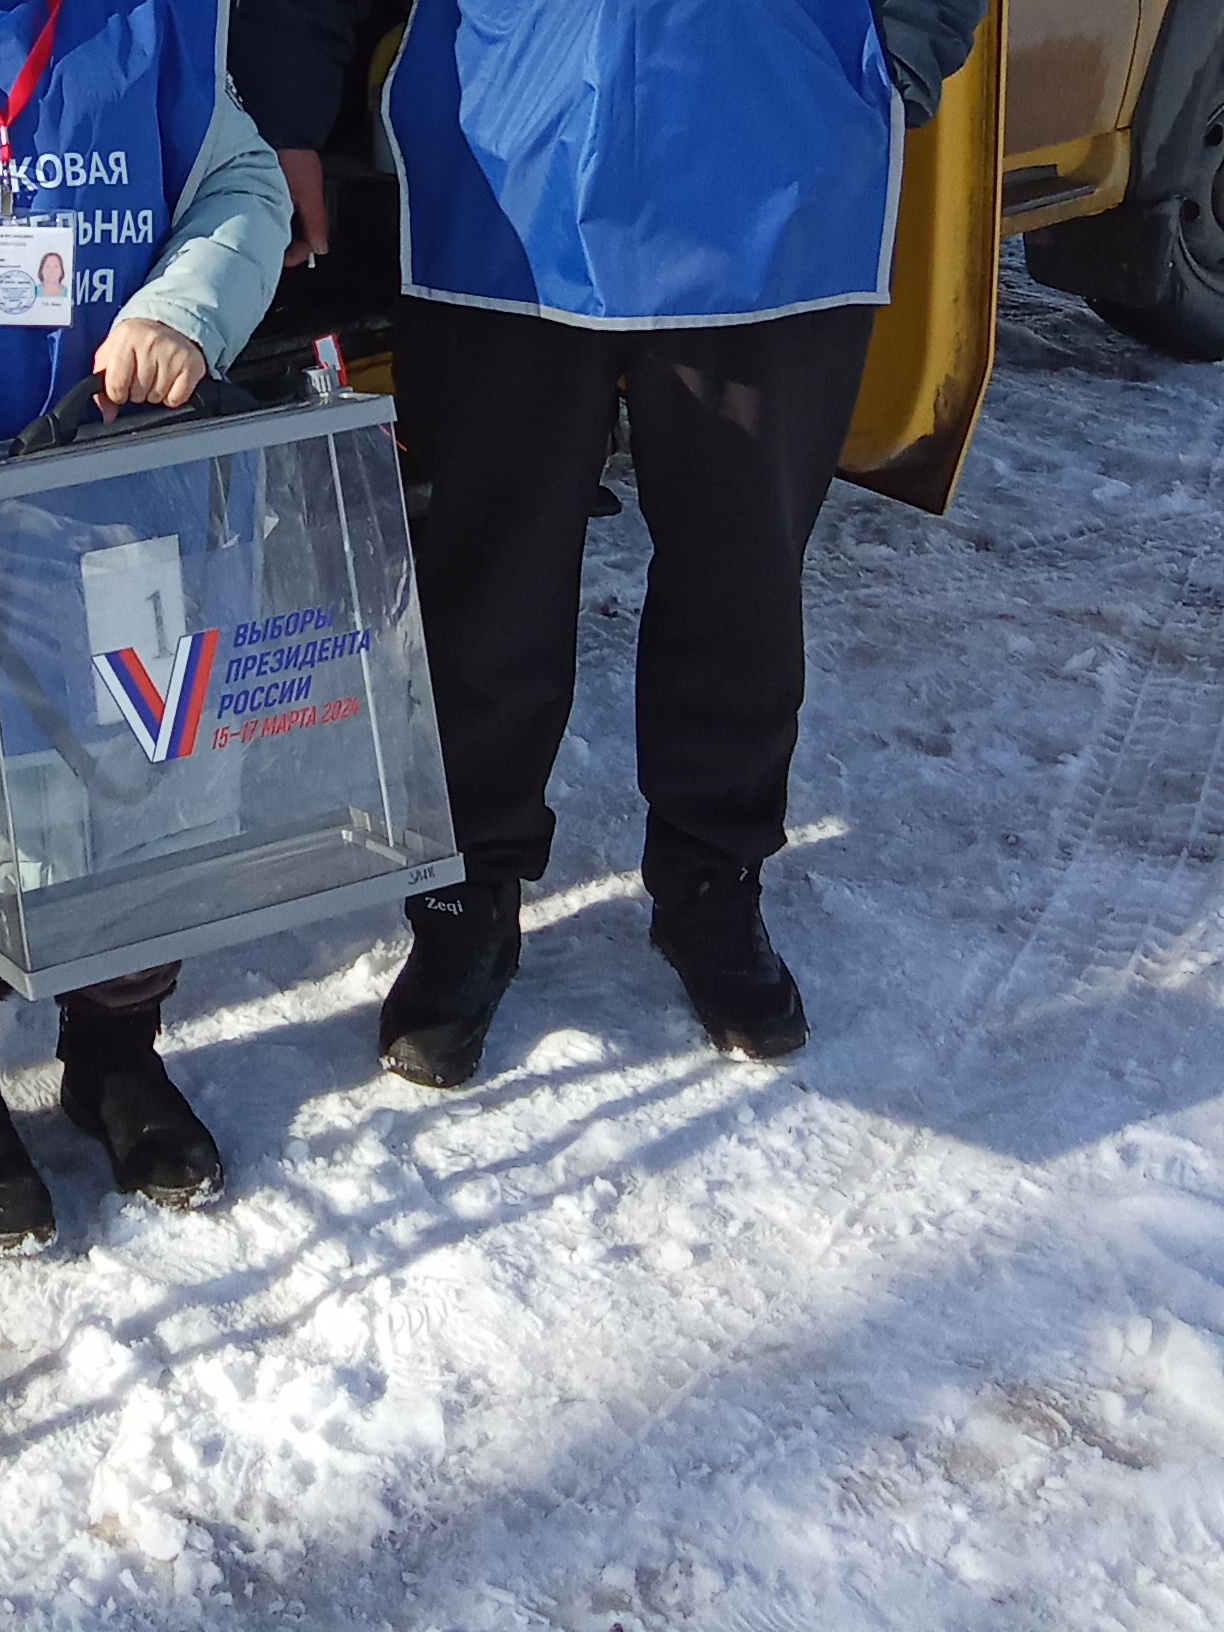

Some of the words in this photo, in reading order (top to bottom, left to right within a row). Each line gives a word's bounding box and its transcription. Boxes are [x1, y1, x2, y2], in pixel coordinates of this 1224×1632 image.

[233, 602, 338, 648] ВЫБОРЫ
[225, 628, 370, 684] ПРЕЗИДЕНТА
[217, 674, 312, 720] РОССИИ
[261, 706, 317, 740] МАРТА
[321, 696, 360, 725] 2024
[425, 896, 464, 917] Zeqi
